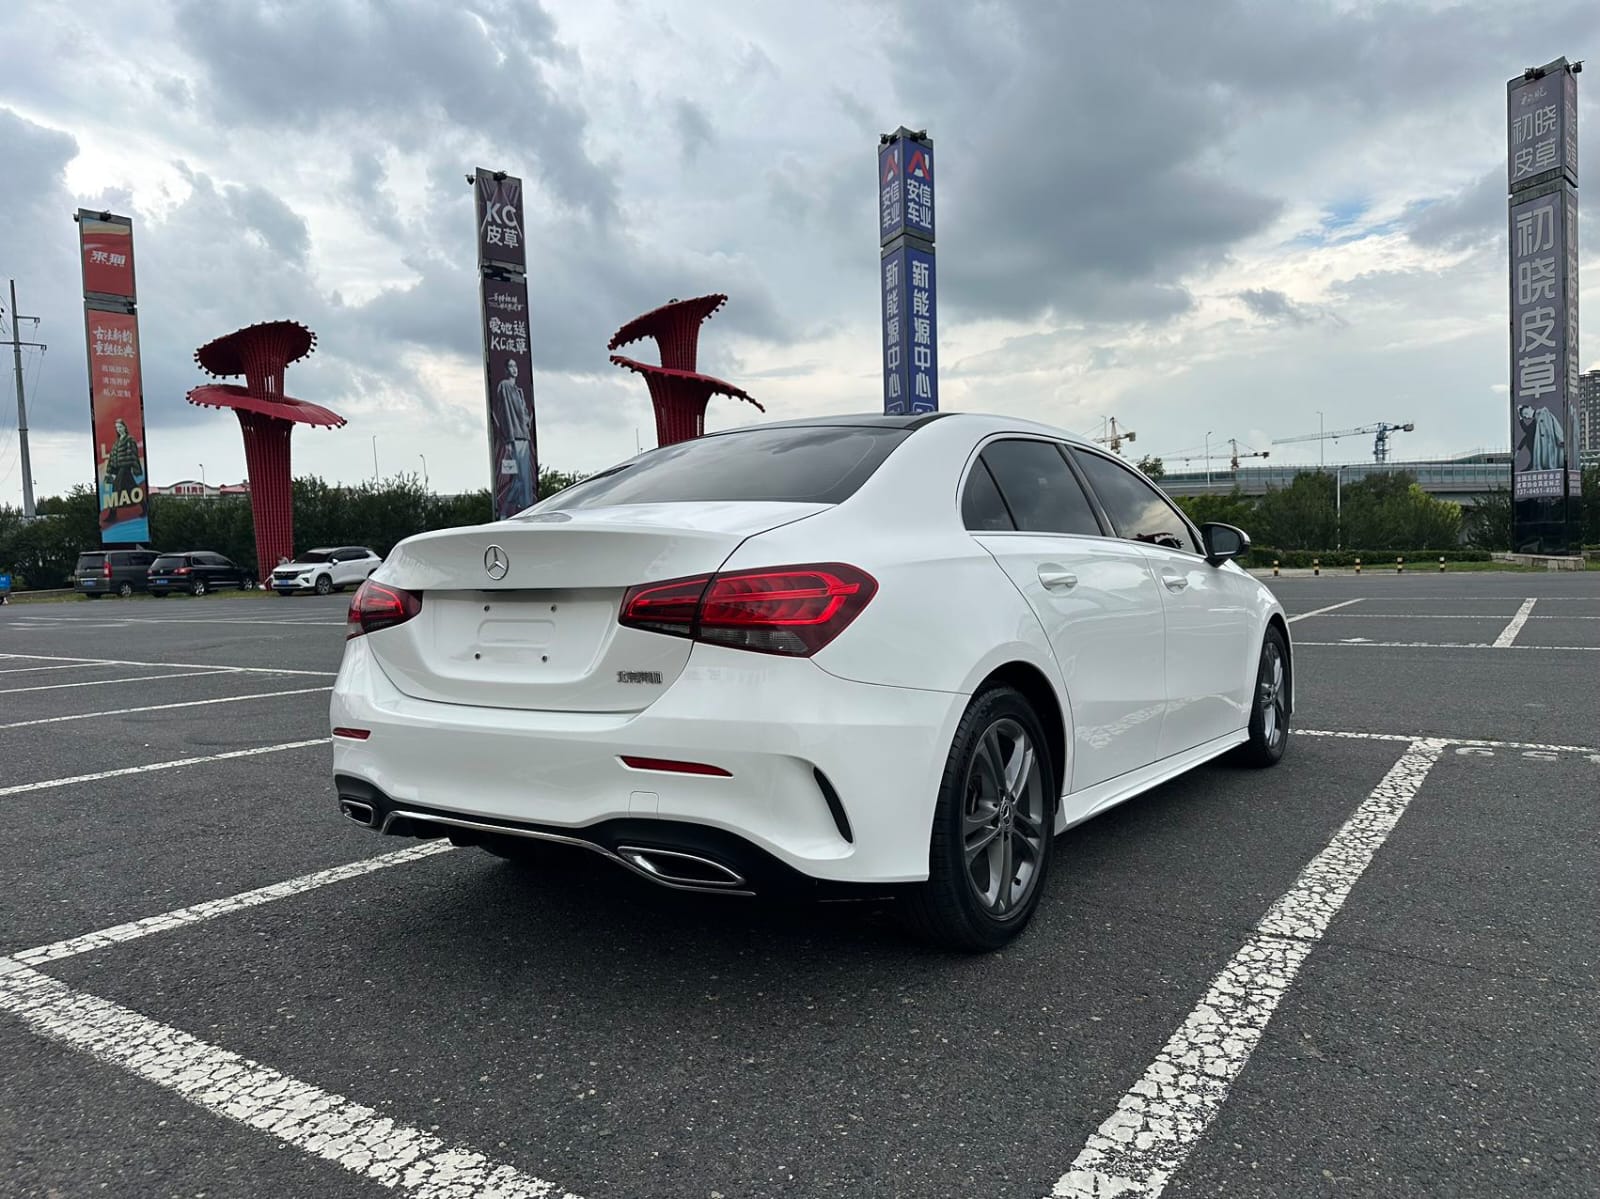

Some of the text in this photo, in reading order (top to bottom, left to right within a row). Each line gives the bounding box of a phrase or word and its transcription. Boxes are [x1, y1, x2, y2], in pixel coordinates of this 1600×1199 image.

[1512, 104, 1557, 145] 初晓
[1513, 137, 1557, 177] 皮草
[907, 178, 931, 206] 安信
[486, 201, 517, 226] KC
[907, 201, 932, 228] 车业
[486, 225, 519, 249] 皮草
[1517, 205, 1557, 399] 初晓皮草
[885, 259, 901, 399] 新能源中心
[912, 260, 932, 399] 新能源中心
[103, 487, 144, 510] MAO
